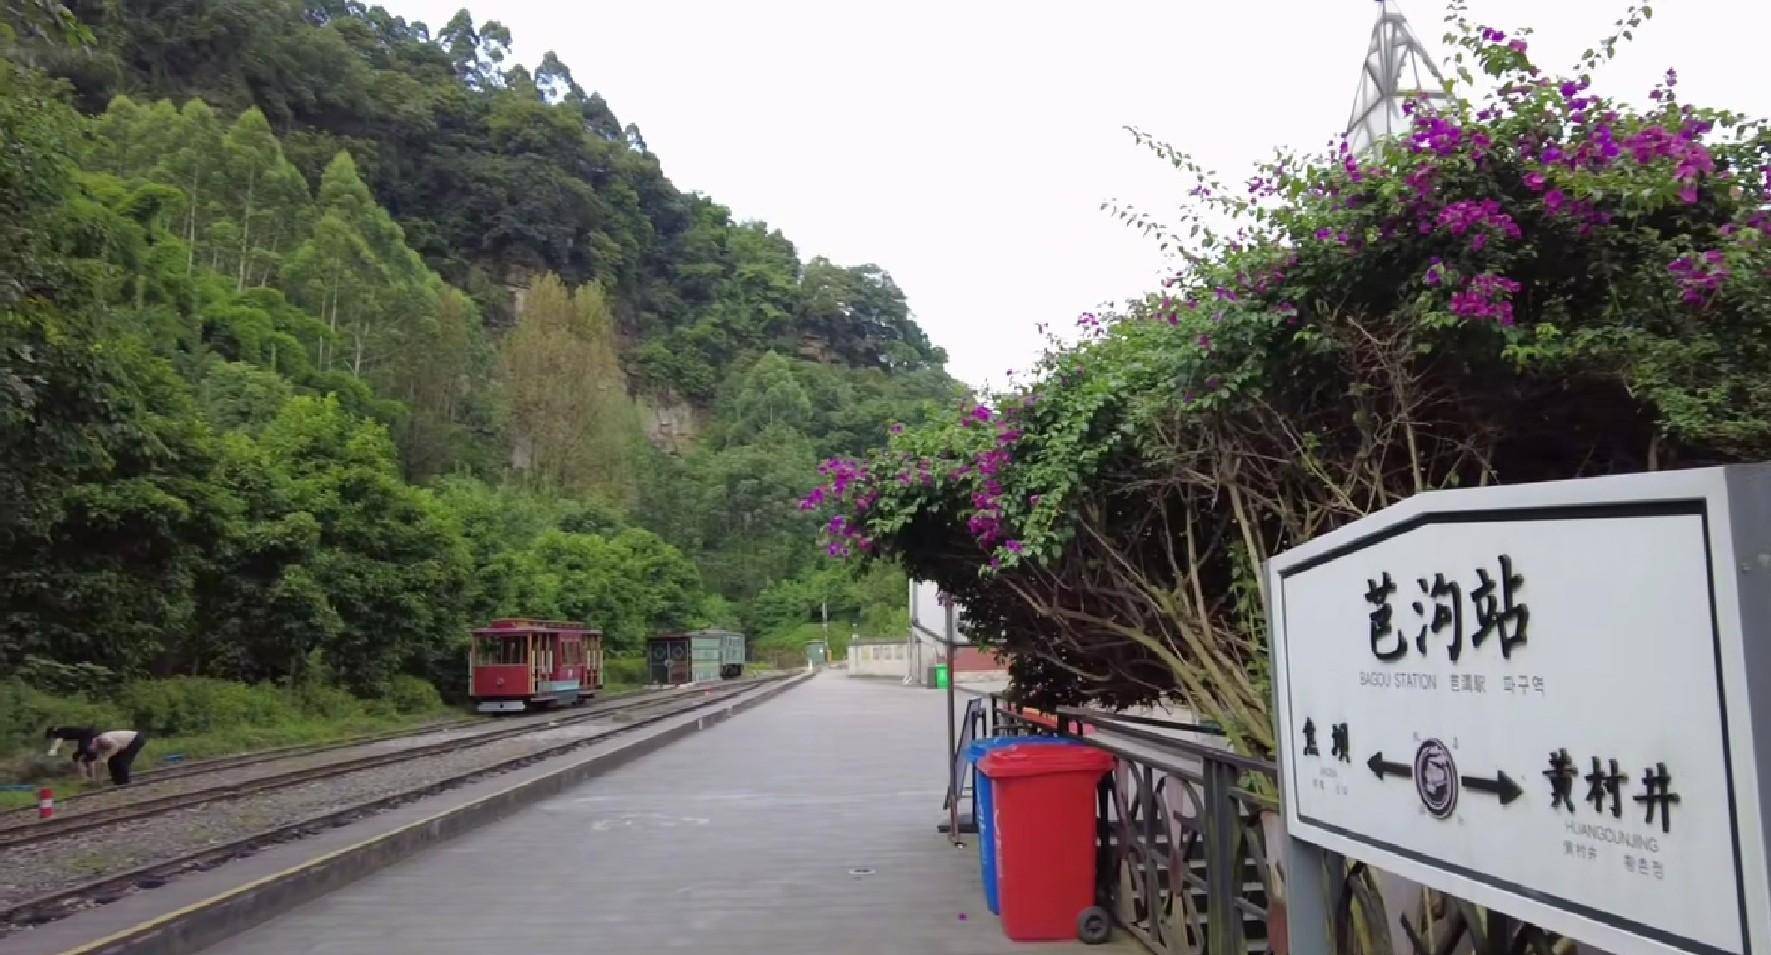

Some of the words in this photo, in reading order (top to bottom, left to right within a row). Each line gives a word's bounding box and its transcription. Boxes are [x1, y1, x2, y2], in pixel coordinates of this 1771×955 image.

[1364, 554, 1529, 663] 芭沟站
[1359, 671, 1392, 687] BAGOU
[1394, 672, 1437, 690] STATION
[1542, 748, 1680, 834] 黄村井
